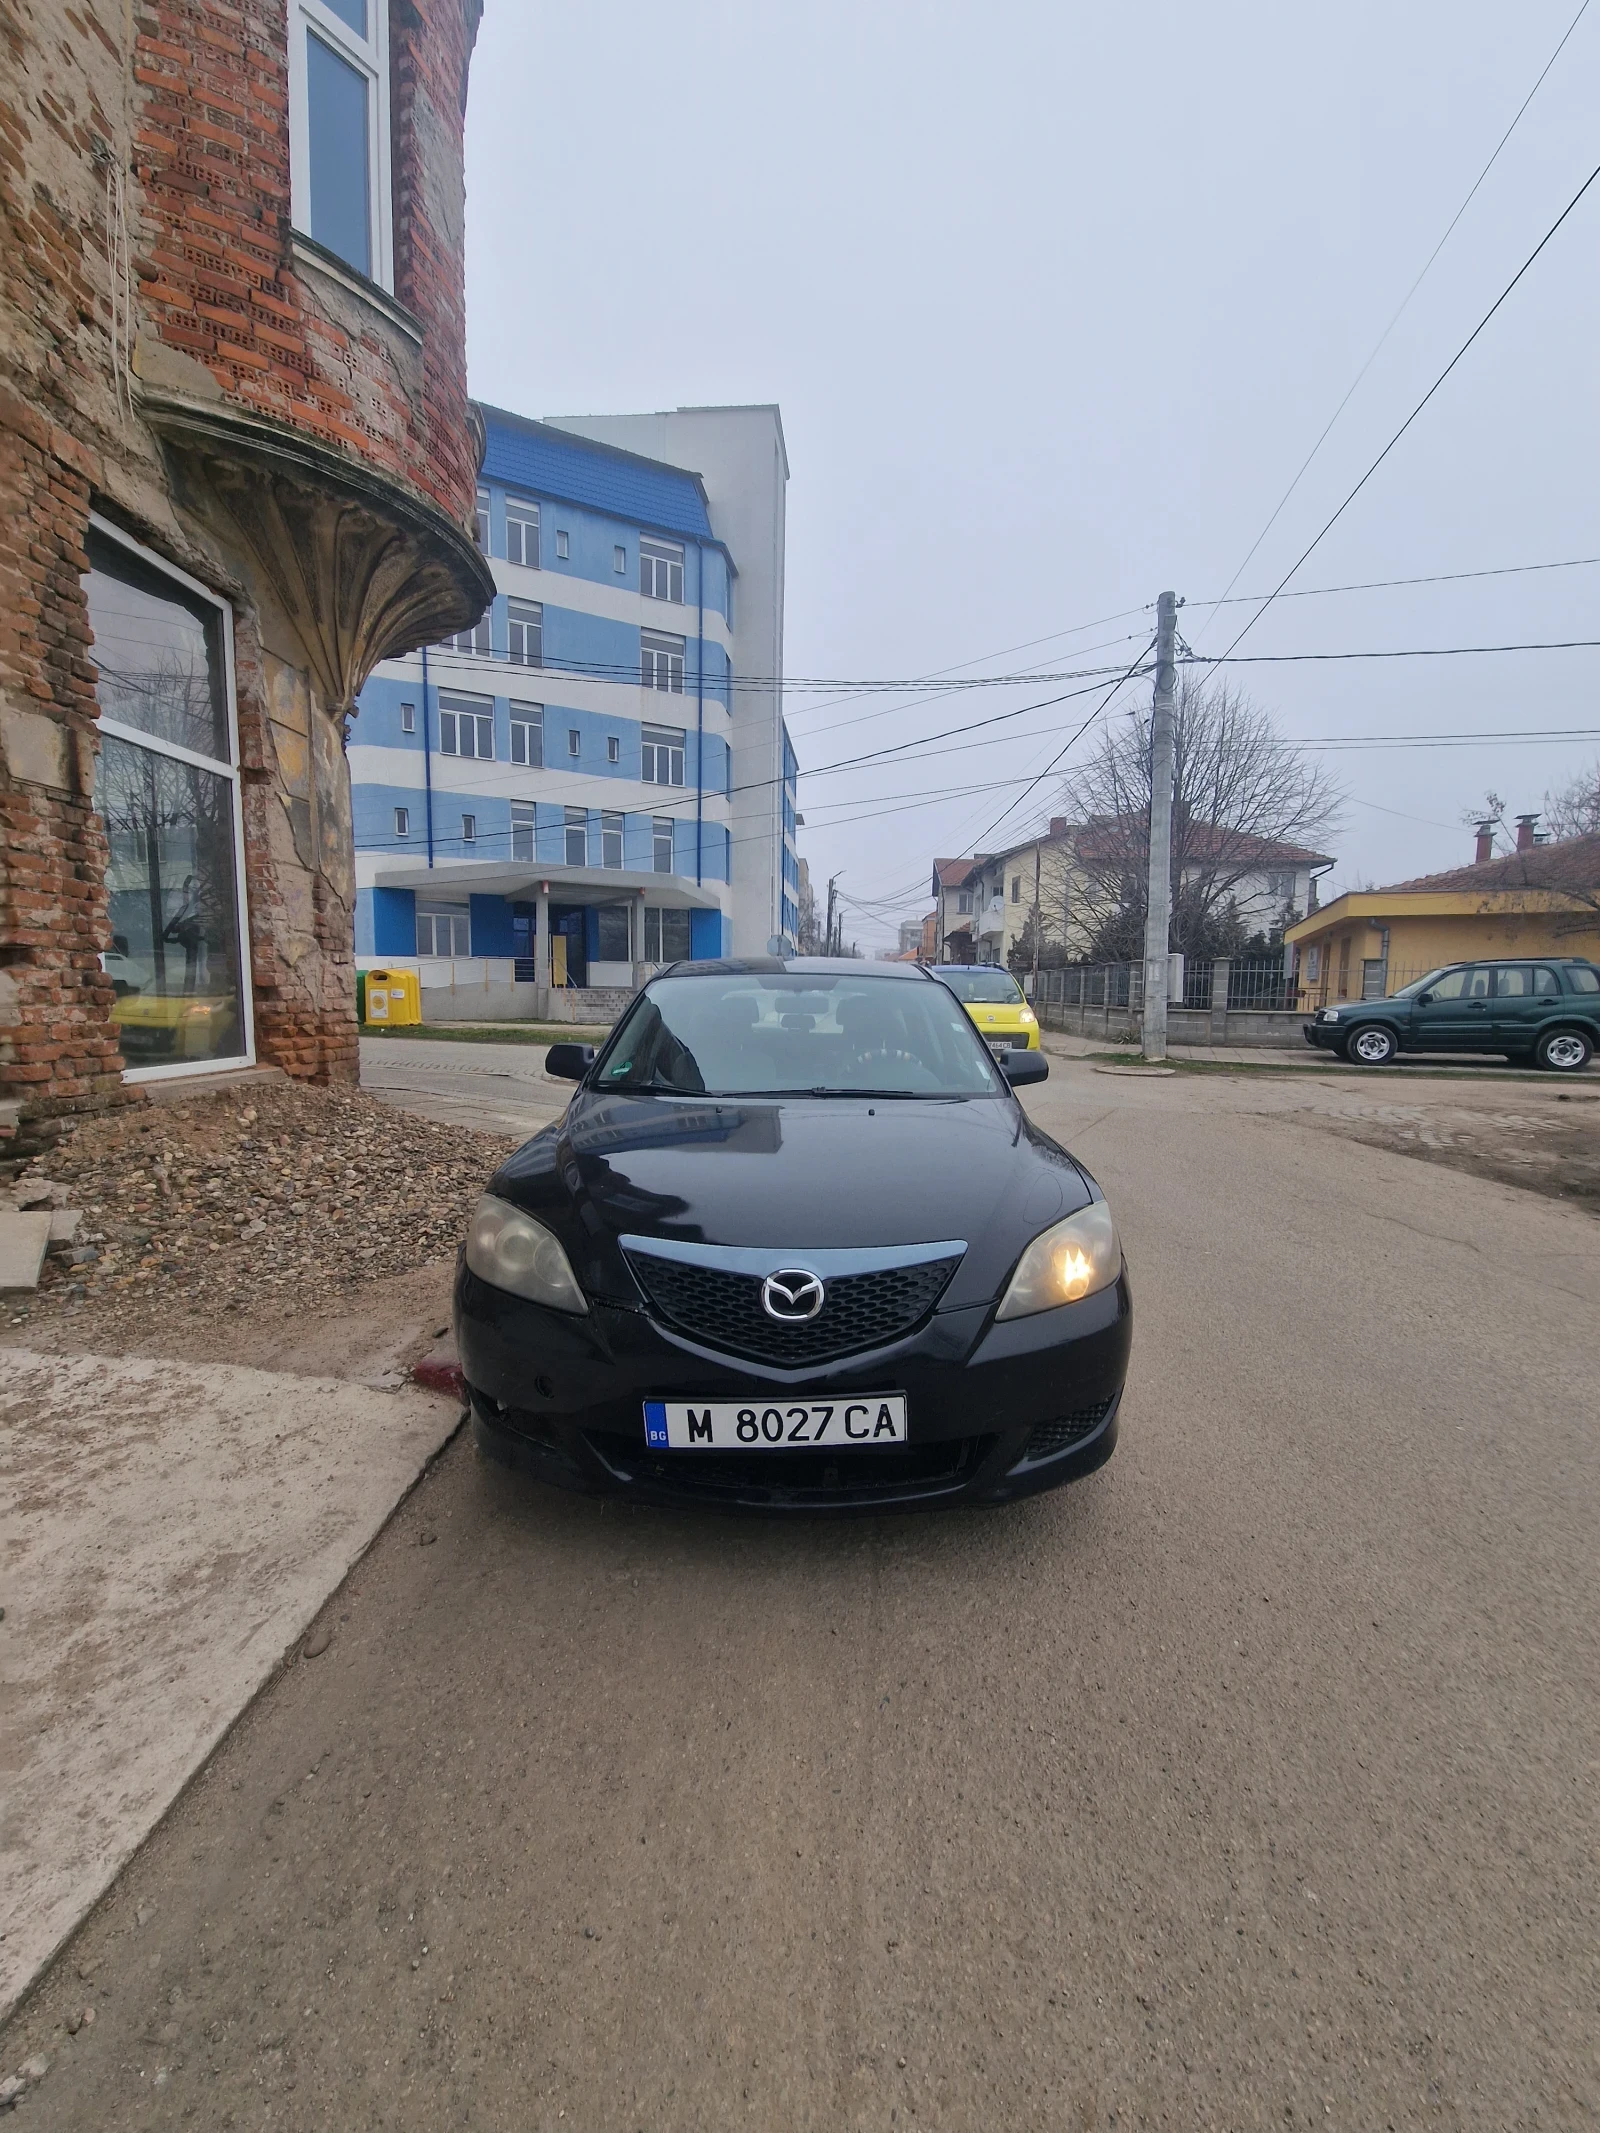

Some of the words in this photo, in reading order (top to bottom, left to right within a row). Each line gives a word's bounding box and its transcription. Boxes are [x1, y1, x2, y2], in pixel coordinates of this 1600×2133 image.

[687, 1409, 714, 1442] M
[736, 1407, 834, 1442] 8027
[845, 1404, 897, 1439] CA
[650, 1430, 666, 1441] BG
